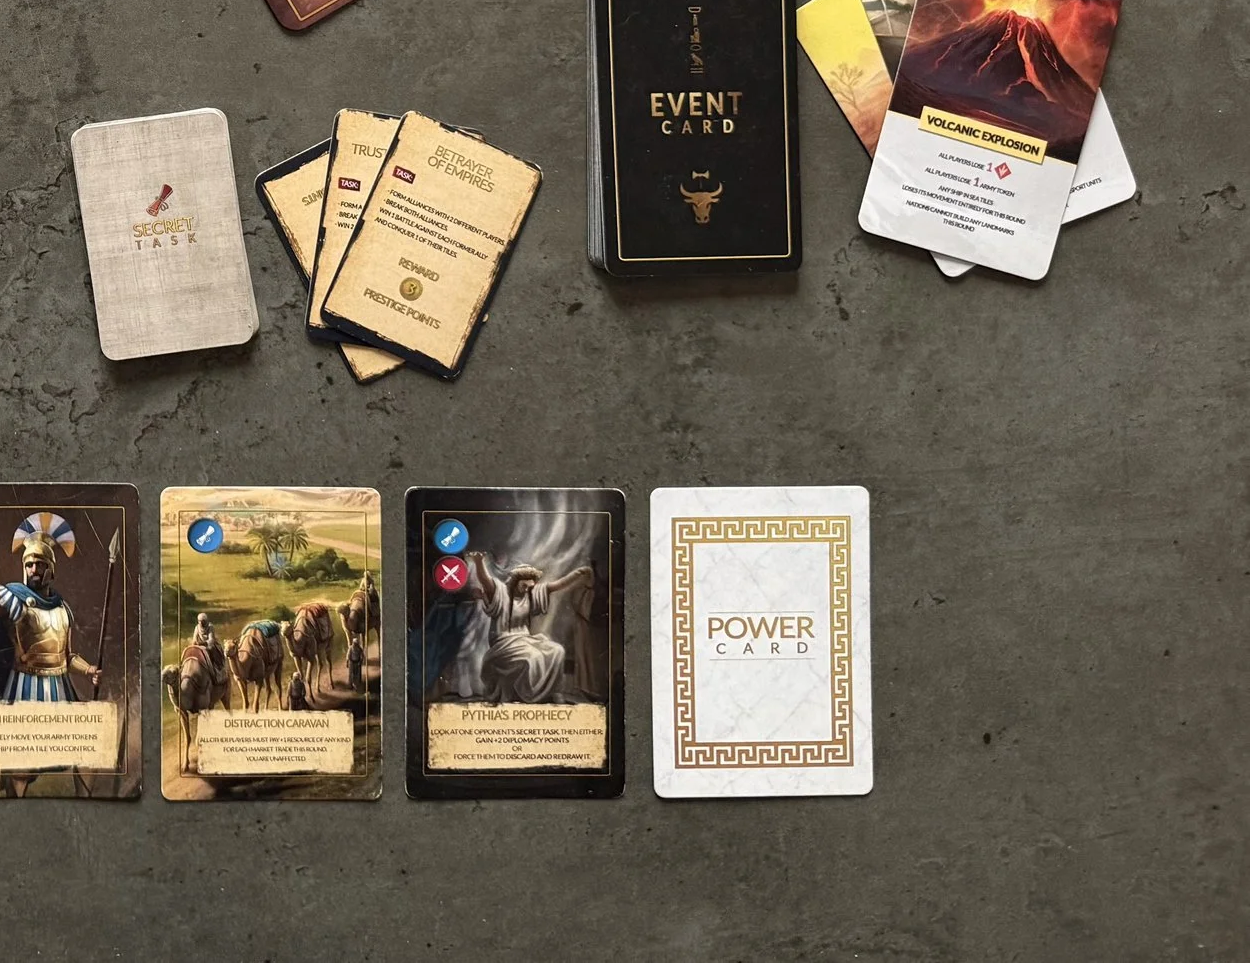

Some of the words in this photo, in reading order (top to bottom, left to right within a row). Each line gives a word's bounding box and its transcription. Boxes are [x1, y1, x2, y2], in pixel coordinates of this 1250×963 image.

[649, 91, 744, 118] EVENT
[661, 119, 736, 135] CARD
[925, 114, 981, 138] VOLCANIC
[980, 130, 1040, 155] EXPLOSION
[435, 145, 494, 180] BETRAYER
[341, 179, 359, 189] TASK:
[395, 167, 413, 182] TASK:
[427, 156, 447, 169] OF
[445, 163, 495, 194] EMPIRES
[132, 215, 196, 238] SECRET
[389, 189, 407, 200] FORM
[405, 196, 435, 213] ALLIANCES
[433, 209, 450, 220] WITH
[452, 218, 482, 234] DIFFERENT
[481, 230, 506, 245] PLAYERS.
[135, 233, 199, 251] TASK
[398, 256, 440, 282] REWARD
[407, 281, 417, 295] 3
[362, 287, 408, 314] PRESTIGE
[405, 306, 442, 330] POINTS
[707, 616, 816, 640] POWER
[715, 642, 810, 655] CARD
[2, 715, 74, 724] REINFORCEMENT
[74, 715, 103, 723] ROUTE
[224, 719, 285, 728] DISTRACTION
[286, 719, 330, 728] CARAVAN
[462, 710, 510, 721] PYTHIA'S
[513, 710, 573, 721] PROPHECY
